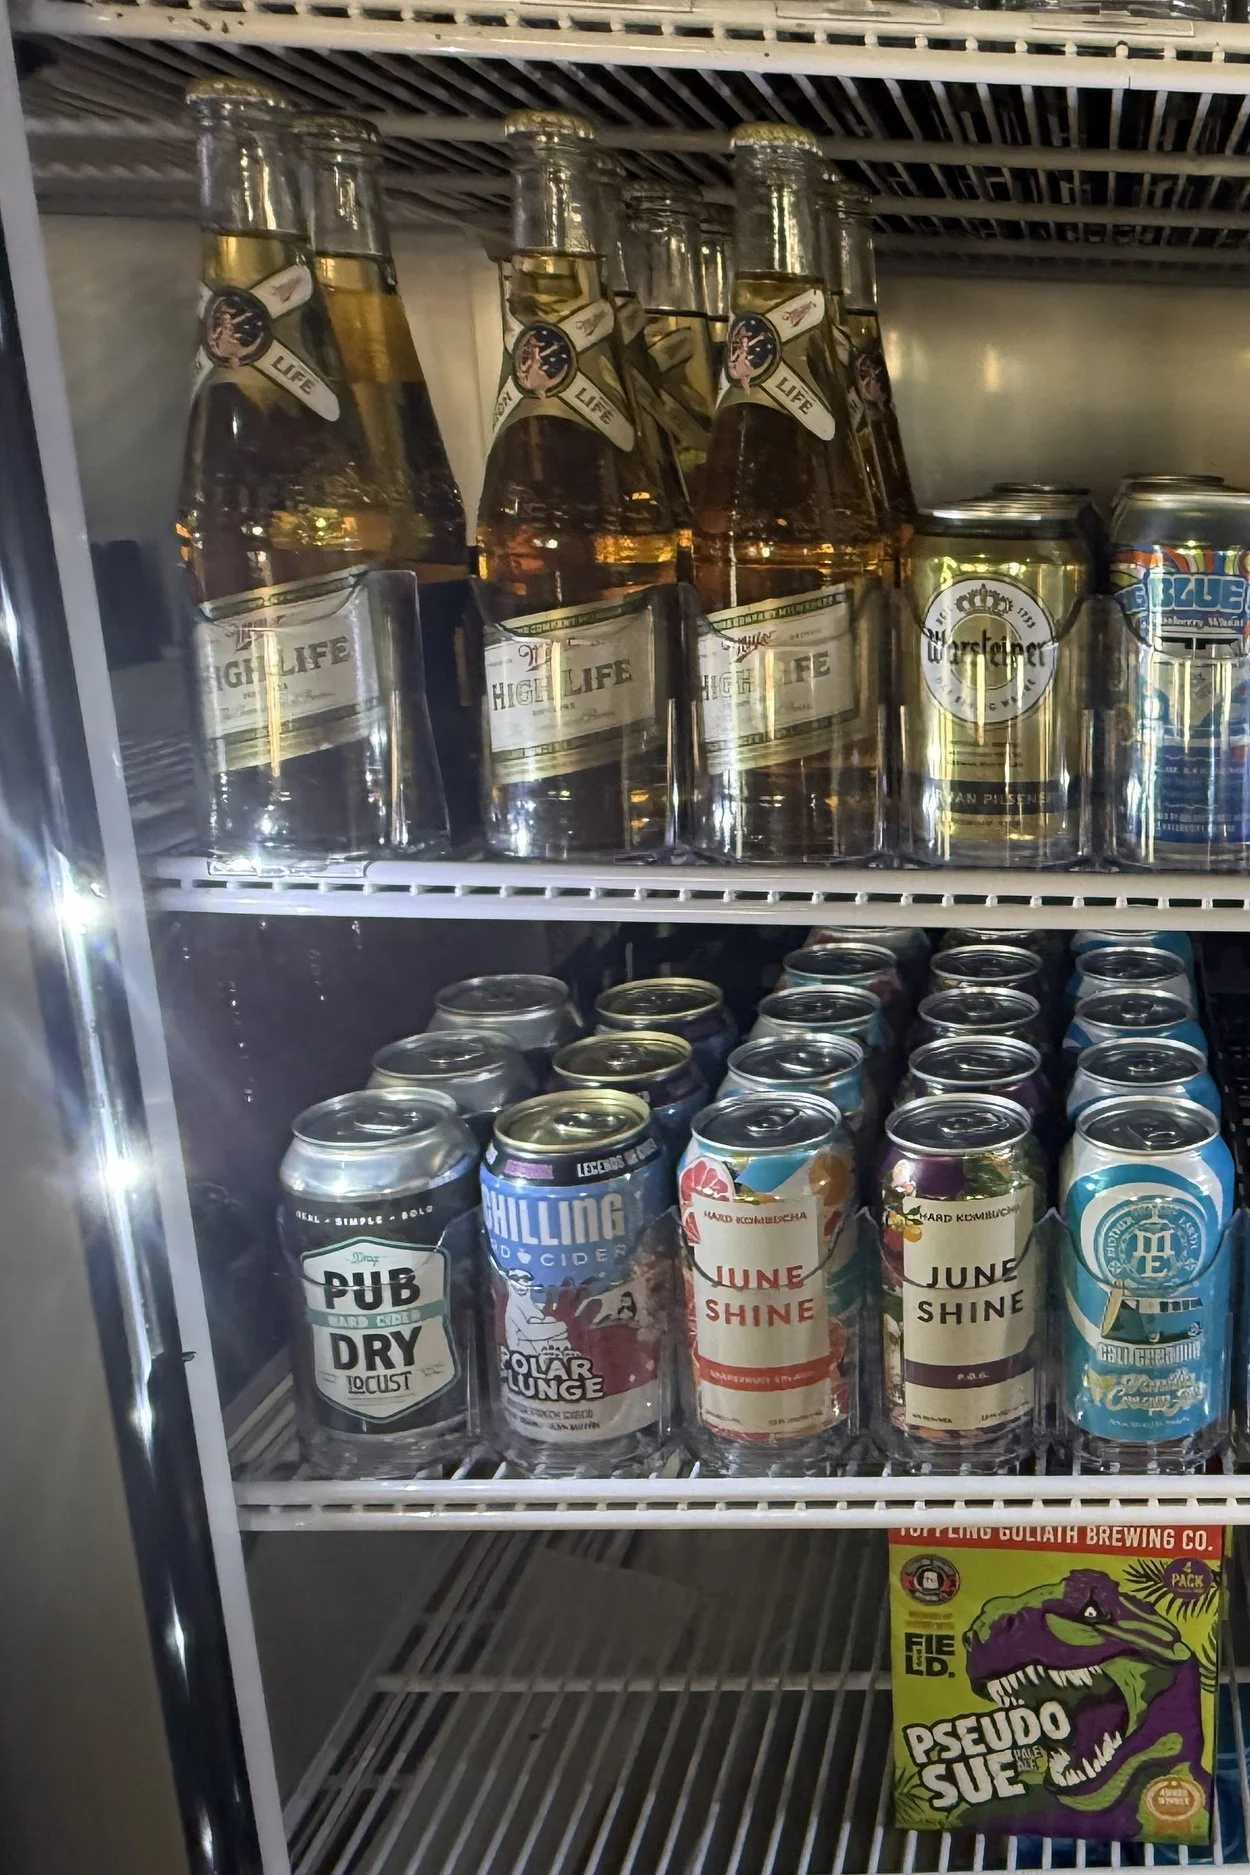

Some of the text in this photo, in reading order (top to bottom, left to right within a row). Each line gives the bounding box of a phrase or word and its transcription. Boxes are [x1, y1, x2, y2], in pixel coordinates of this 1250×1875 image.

[271, 355, 320, 396] LIFE
[573, 386, 614, 427] LIFE
[775, 376, 812, 415] LIFE
[1147, 574, 1247, 613] BLUE
[214, 635, 350, 692] IGH LIFE
[701, 650, 832, 701] HIGH IFE
[492, 658, 633, 711] HIGH LIFE
[983, 792, 1047, 806] PILSENE
[335, 1215, 383, 1226] SIMPLE
[480, 1183, 626, 1246] CHILLING
[703, 1209, 808, 1225] HARD KOMBUCHA
[919, 1211, 953, 1223] HARD
[540, 1243, 627, 1267] CIDER
[323, 1267, 422, 1312] PUB
[714, 1264, 805, 1290] JUNE
[926, 1257, 1018, 1290] JUNE
[326, 1308, 422, 1329] HARD CIDER
[705, 1298, 815, 1327] SHINE
[916, 1289, 1025, 1325] SHINE
[329, 1325, 423, 1372] DRY
[347, 1370, 413, 1394] LOCUST
[501, 1367, 604, 1401] LUNGE
[999, 1526, 1078, 1544] GOLIATH
[1085, 1525, 1176, 1550] BREWING
[1181, 1529, 1214, 1551] CO.
[1171, 1573, 1204, 1589] PACK
[905, 1700, 1071, 1764] PSEUDO
[920, 1748, 1027, 1809] SUE
